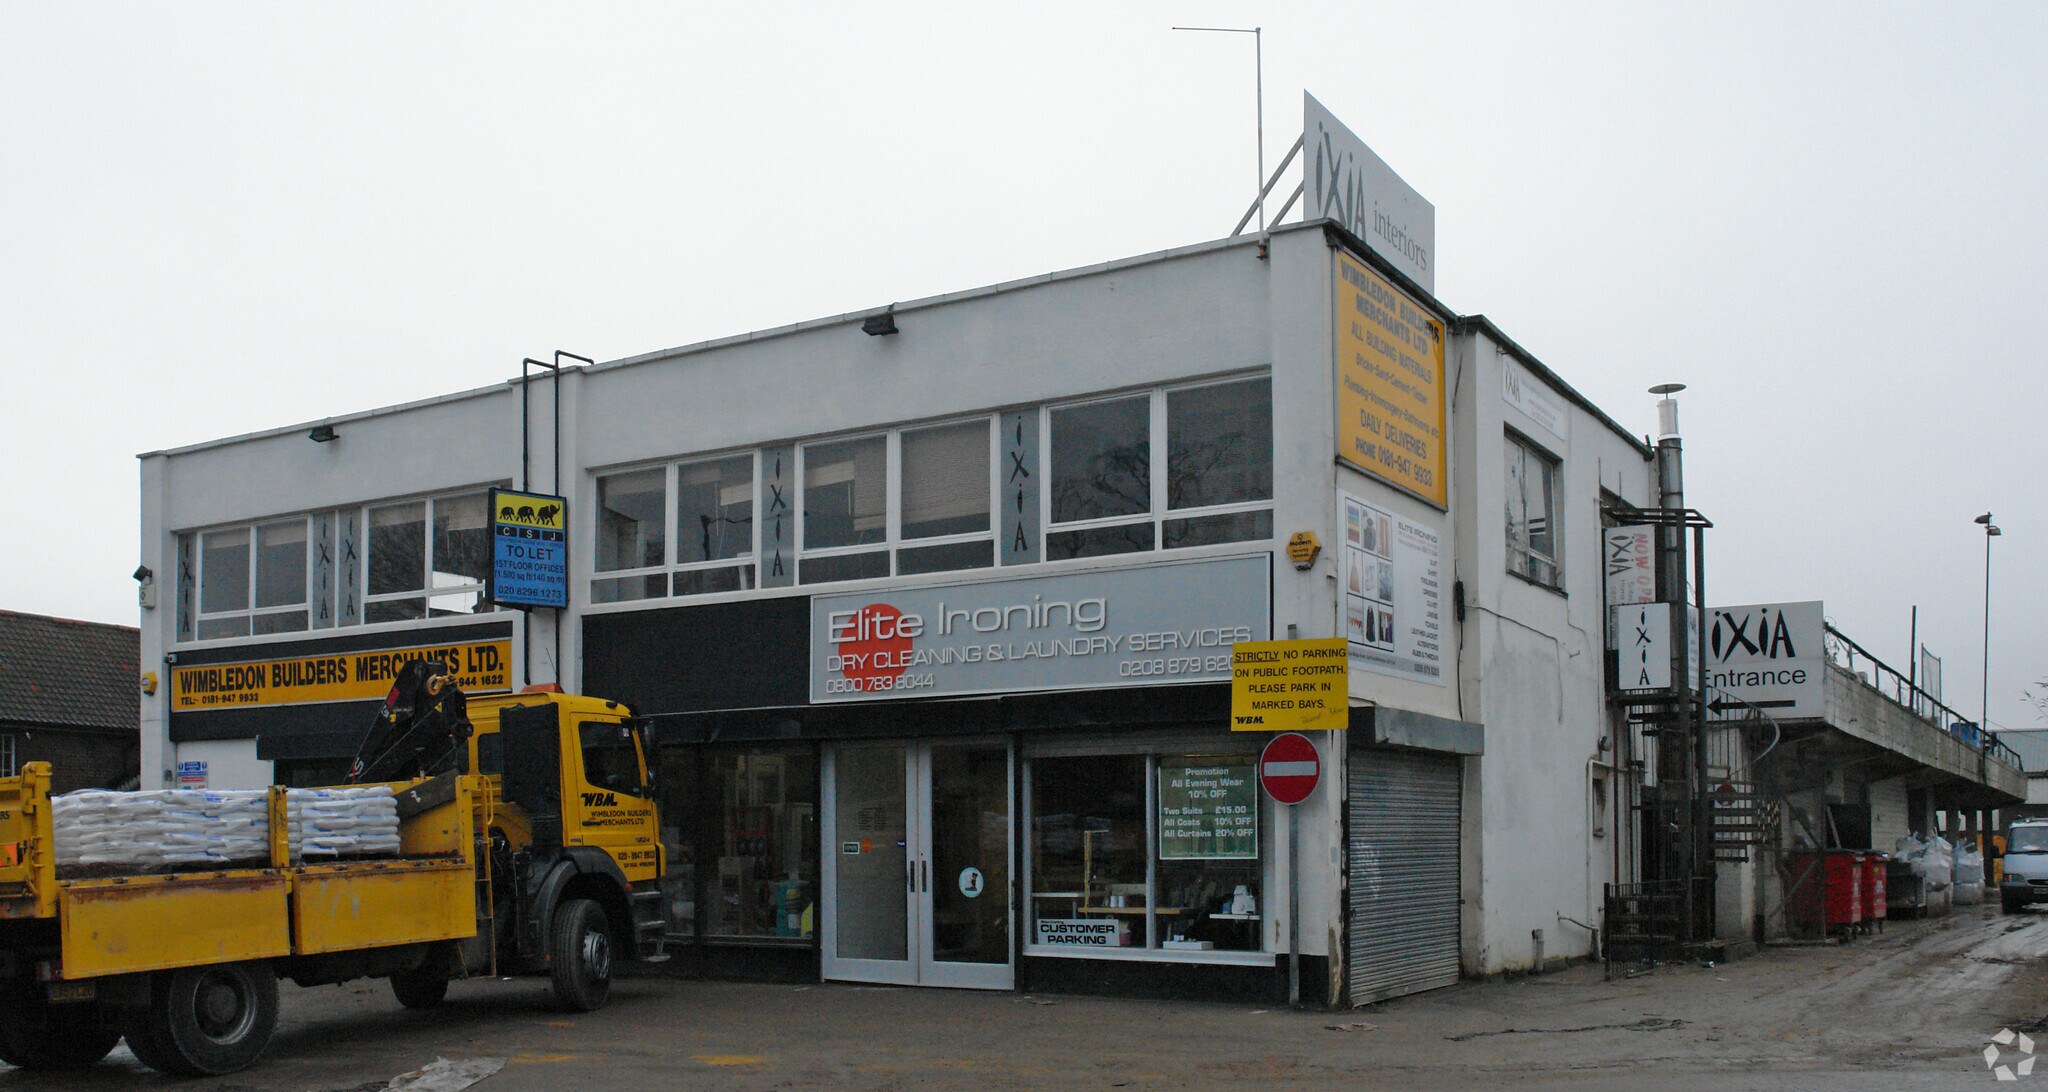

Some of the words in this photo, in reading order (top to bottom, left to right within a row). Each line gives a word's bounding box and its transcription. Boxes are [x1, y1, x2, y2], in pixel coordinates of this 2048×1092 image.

[1374, 201, 1426, 271] interiors
[1341, 259, 1396, 313] WIMBLEDON
[1400, 303, 1439, 344] BUILDERS
[1356, 293, 1410, 345] MERCHANTS
[1413, 331, 1428, 356] LTD
[1351, 320, 1363, 342] ALL
[1366, 329, 1397, 362] BUILDING
[1399, 351, 1432, 384] MATERIALS
[1360, 408, 1382, 435] DAILY
[1384, 422, 1427, 460] DELIVERIES
[1355, 436, 1376, 460] PHONE
[1378, 445, 1411, 477] 0181-947
[1413, 463, 1432, 488] 9933
[506, 545, 525, 558] TO
[528, 546, 553, 560] LET
[1633, 533, 1650, 569] NOW
[495, 560, 507, 568] 1ST
[509, 561, 533, 571] FLOOR
[534, 563, 564, 573] OFFICES
[498, 585, 515, 594] 020
[517, 586, 538, 596] 8296
[541, 589, 562, 599] 1273
[828, 608, 924, 643] Elite
[938, 594, 1106, 635] Ironing
[827, 653, 870, 672] DRY
[874, 645, 982, 669] CLEANING
[986, 644, 1005, 661] &
[1009, 635, 1124, 660] LAUNDRY
[1129, 626, 1252, 651] SERVICES
[1234, 651, 1280, 663] STRICTLY
[1284, 650, 1298, 659] NO
[1303, 648, 1347, 658] PARKING
[180, 665, 266, 694] WIMBLEDON
[272, 657, 347, 688] BUILDERS
[467, 645, 504, 673] LTD.
[1119, 660, 1164, 677] 0208
[1168, 657, 1201, 675] 879
[1234, 668, 1249, 678] ON
[1253, 667, 1288, 677] PUBLIC
[1293, 665, 1347, 676] FOOTPATH.
[459, 677, 476, 687] 944
[481, 674, 504, 685] 1622
[826, 677, 863, 694] 0800
[866, 675, 893, 692] 783
[896, 673, 935, 690] 8044
[1249, 684, 1286, 693] PLEASE
[1291, 683, 1316, 692] PARK
[1321, 682, 1331, 691] IN
[202, 694, 236, 704] 0181-947
[239, 693, 259, 702] 9933
[1252, 700, 1294, 710] MARKED
[1299, 699, 1326, 709] BAYS.
[1185, 768, 1229, 776] Promotion
[1171, 779, 1183, 788] All
[1185, 779, 1217, 788] Evening
[1220, 778, 1244, 787] Wear
[1210, 790, 1227, 798] OFF
[1163, 807, 1180, 815] Two
[1182, 807, 1203, 815] Suits
[1215, 806, 1247, 814] £15.00
[1164, 818, 1175, 826] All
[1177, 818, 1200, 826] Coats
[1214, 818, 1232, 826] 10%
[1235, 817, 1252, 825] OFF
[1177, 829, 1211, 837] Curtains
[1215, 829, 1234, 837] 20%
[618, 852, 628, 860] 020
[644, 850, 656, 859] 9933
[1041, 924, 1115, 933] CUSTOMER
[1047, 935, 1107, 944] PARKING
